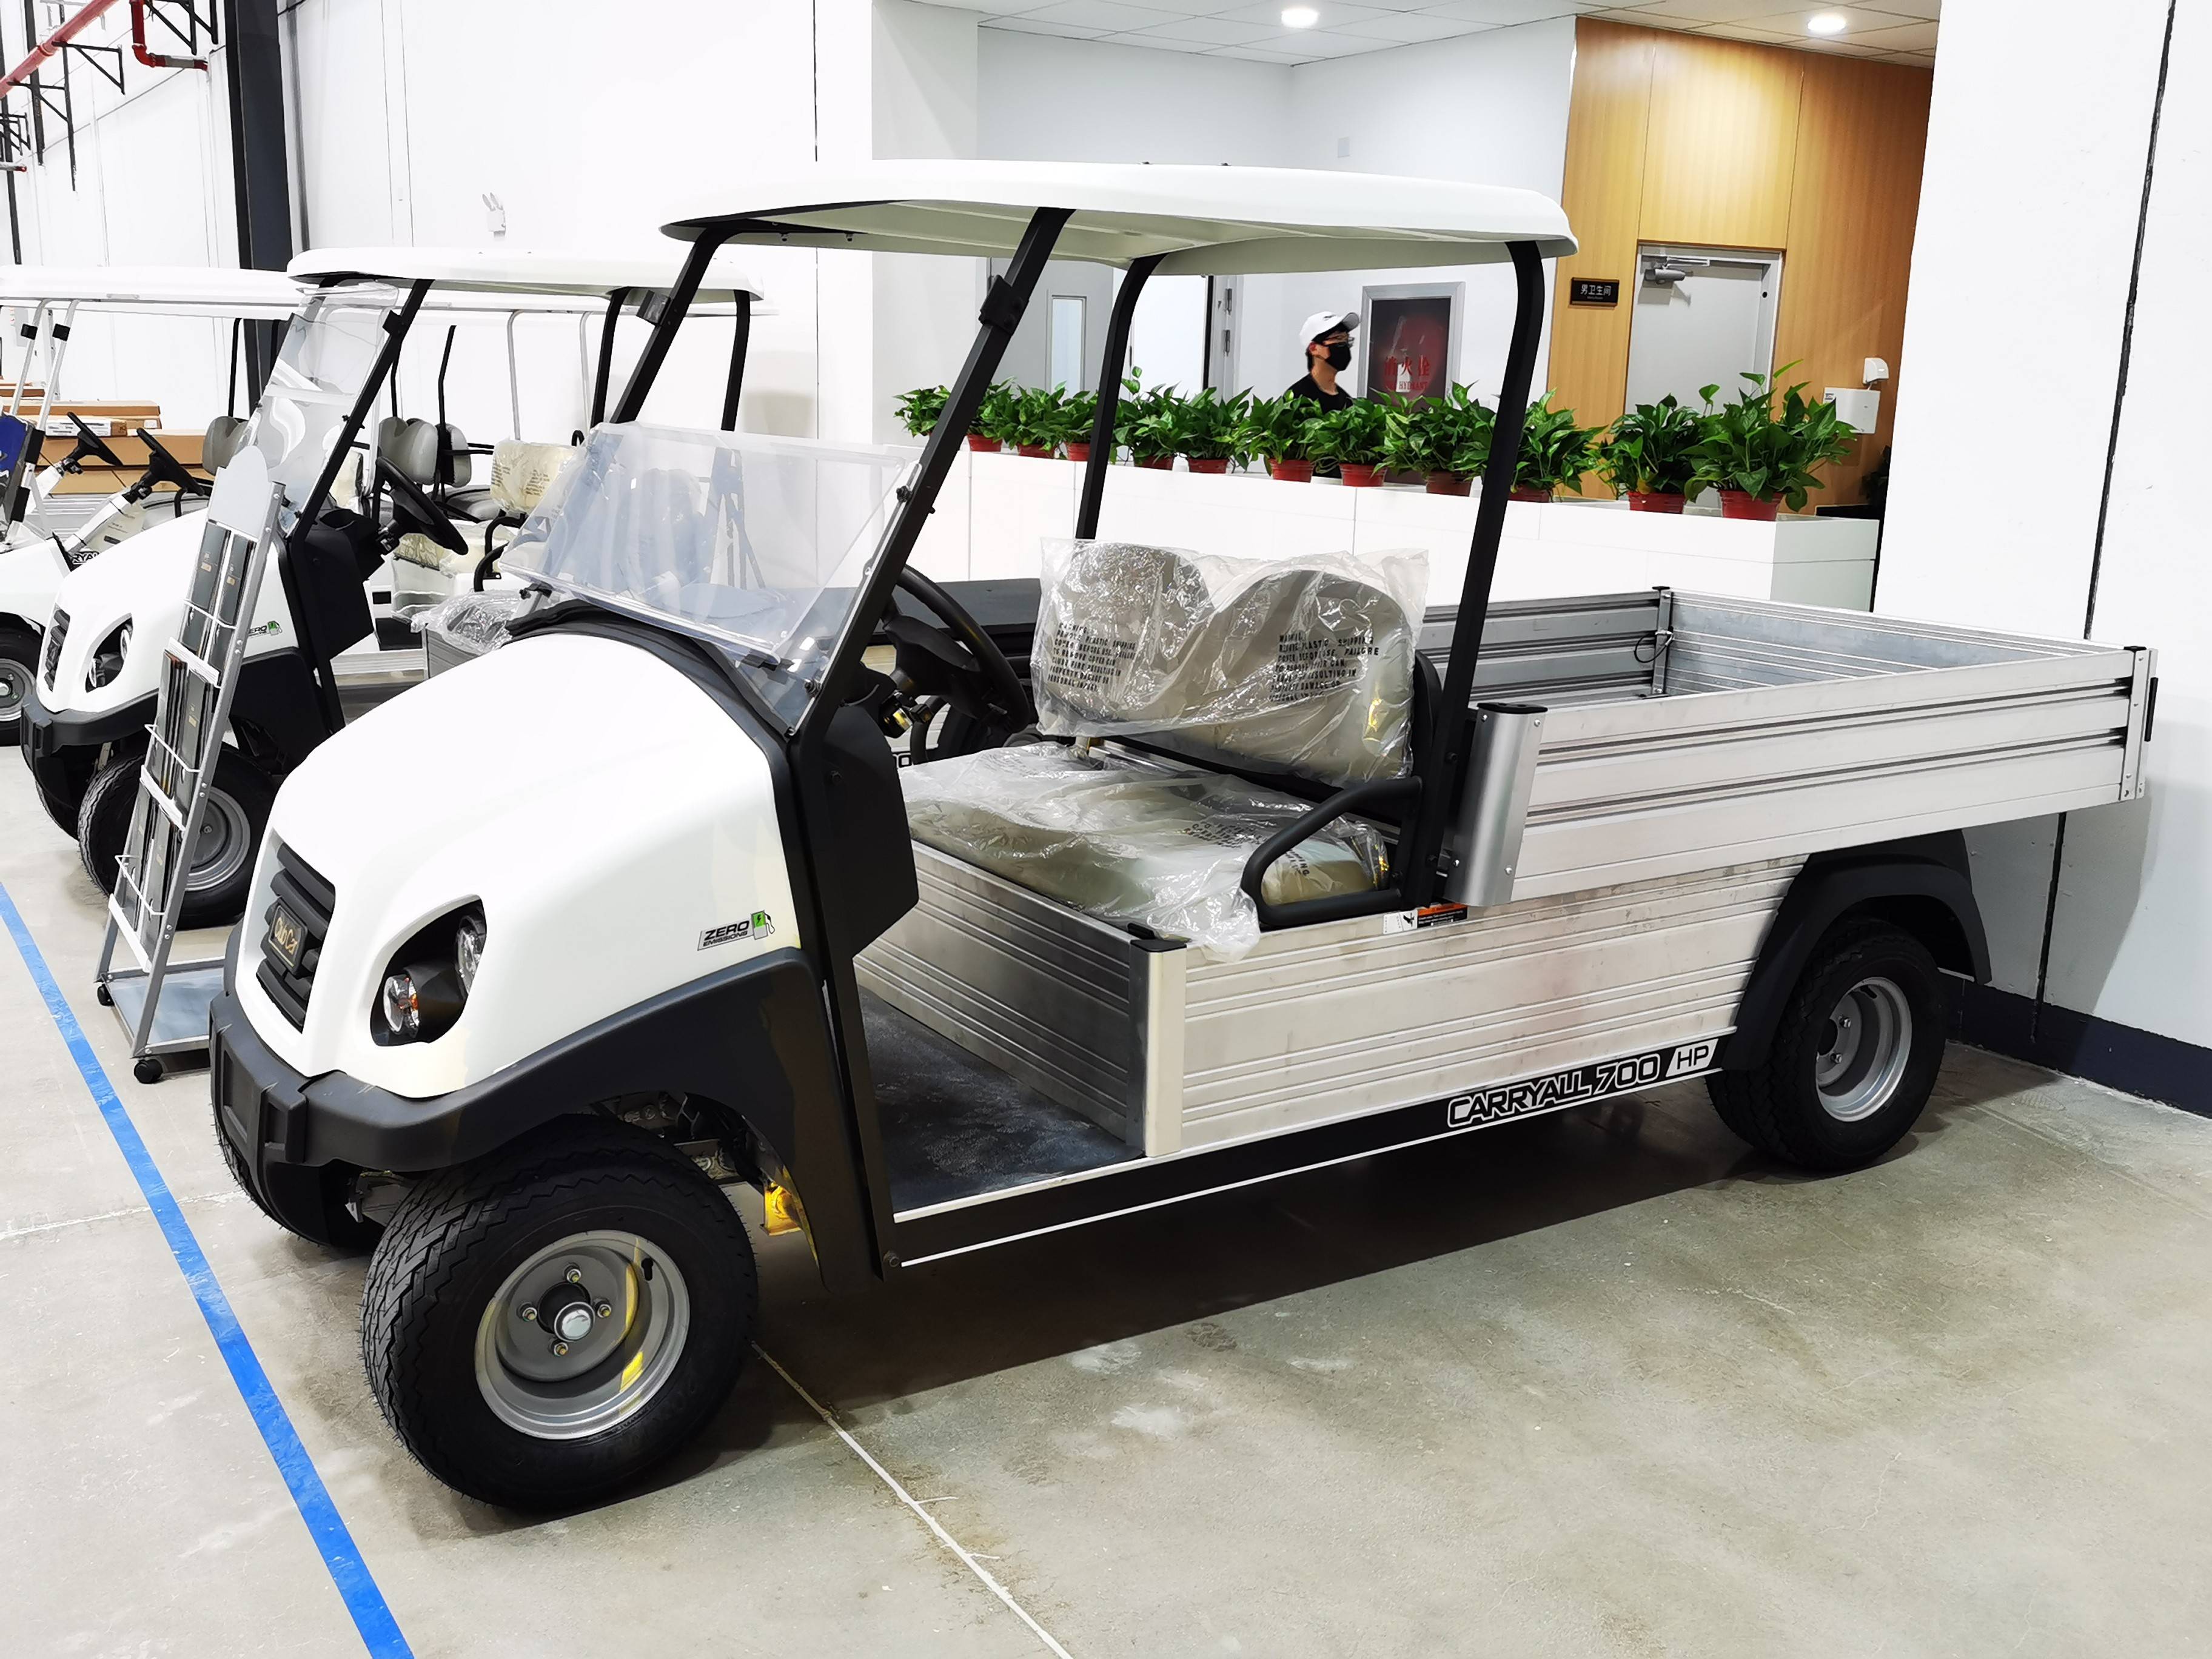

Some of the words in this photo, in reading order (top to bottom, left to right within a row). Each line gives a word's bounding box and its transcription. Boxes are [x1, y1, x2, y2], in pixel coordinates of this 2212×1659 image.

[1580, 284, 1612, 297] 男卫生间
[1384, 356, 1429, 376] 消火栓
[249, 625, 267, 634] ERO
[1299, 651, 1321, 661] BEFOR
[1344, 647, 1379, 656] FAILURE
[703, 930, 748, 947] EMISSIONS
[704, 920, 750, 941] ZERO
[1447, 1071, 1592, 1127] CARRYALL
[1594, 1054, 1660, 1095] 700
[1677, 1044, 1709, 1070] HP
